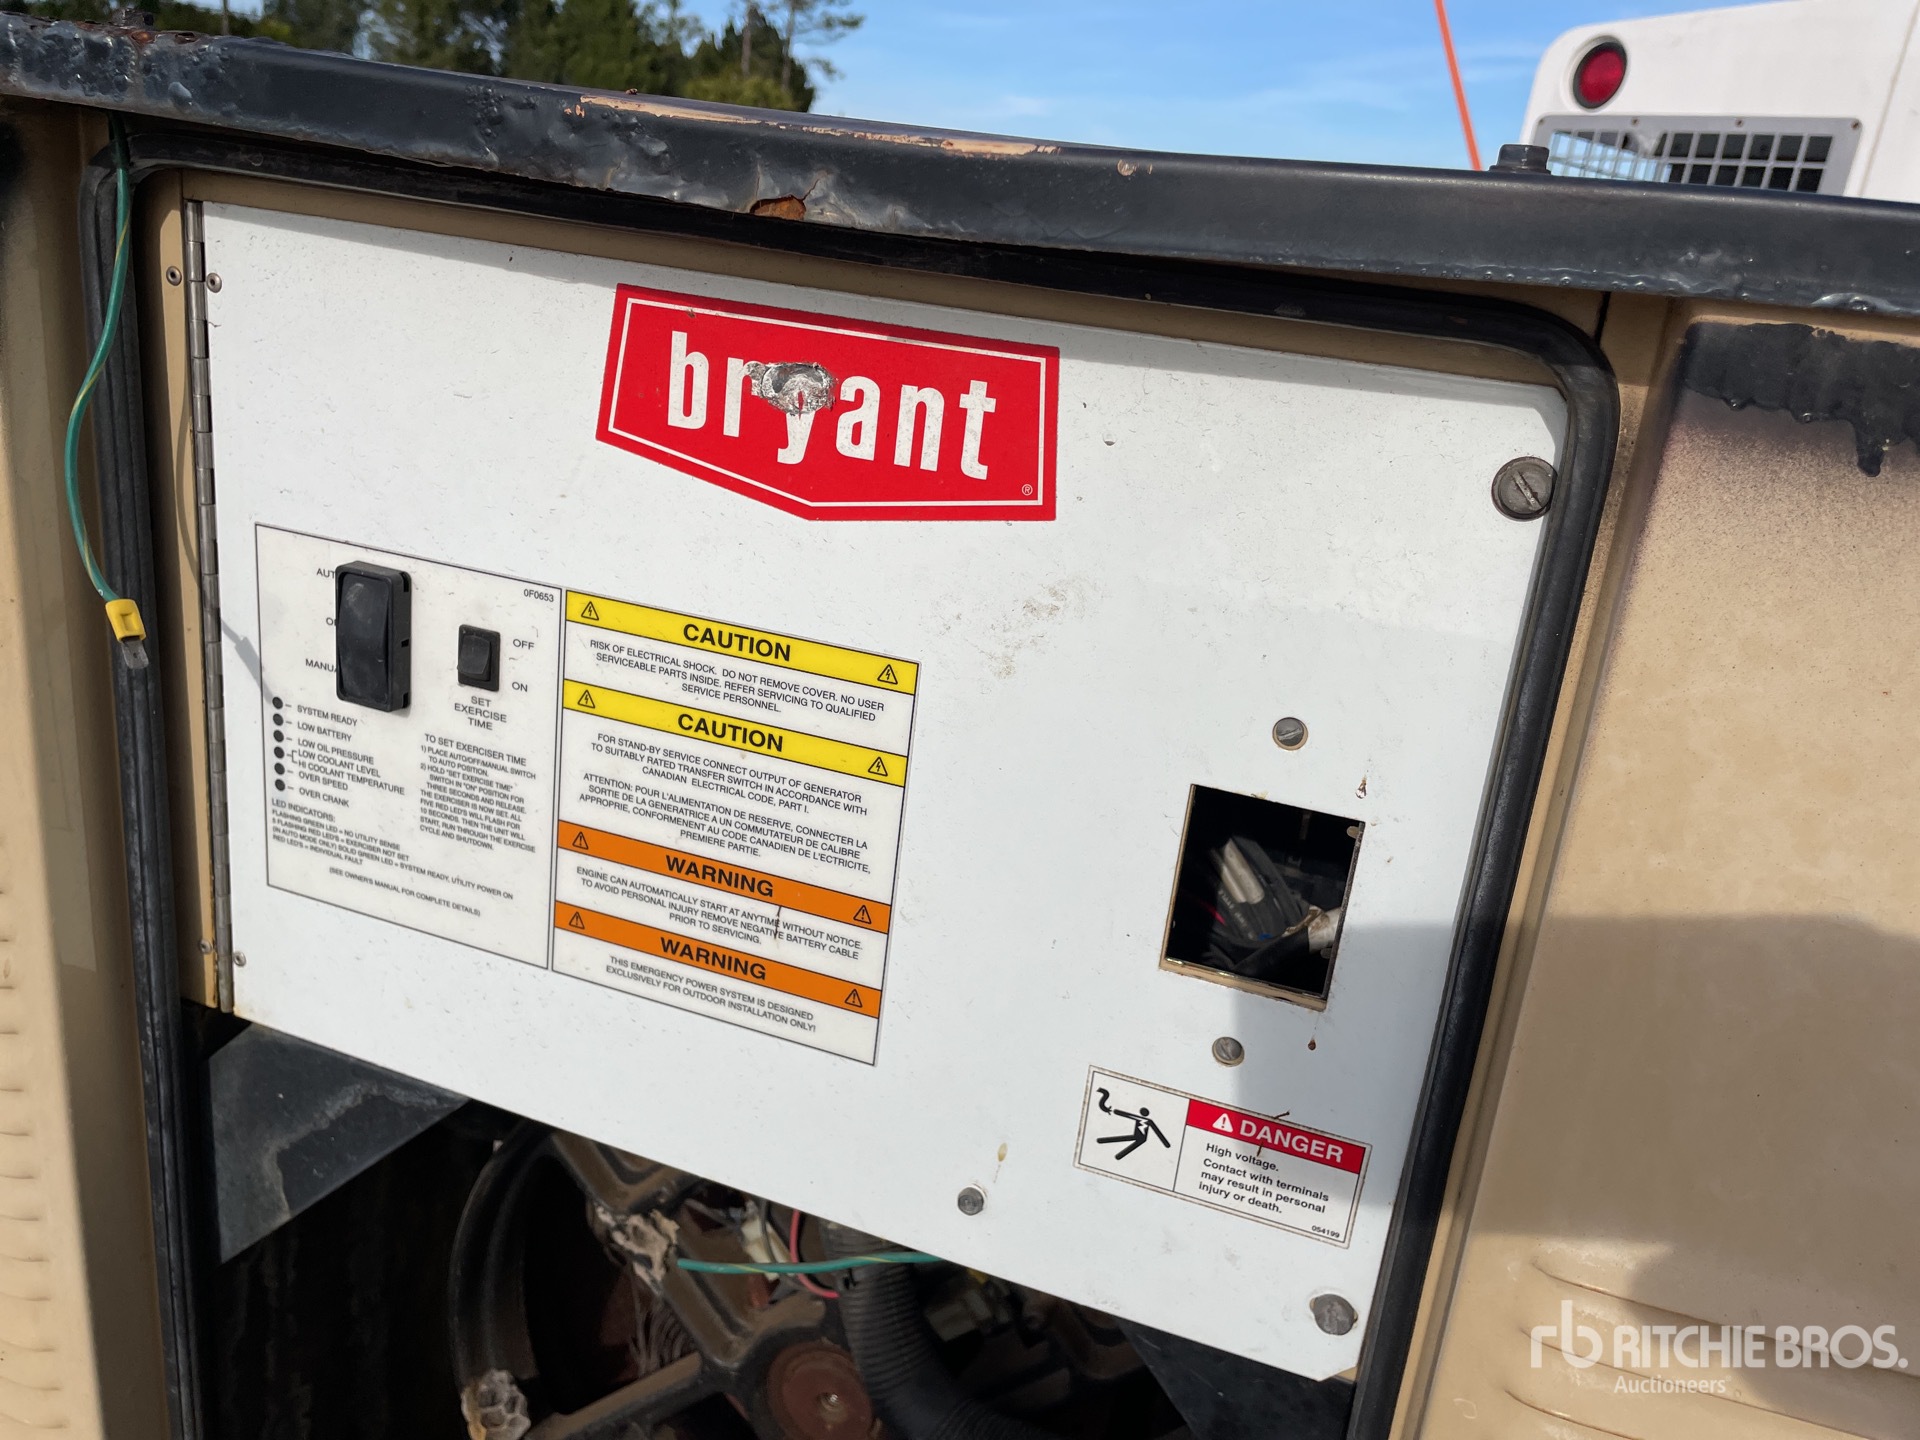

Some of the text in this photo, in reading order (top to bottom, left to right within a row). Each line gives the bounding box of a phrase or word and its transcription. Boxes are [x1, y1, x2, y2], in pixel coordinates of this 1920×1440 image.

[667, 330, 996, 480] bryant
[316, 567, 334, 579] AUT
[512, 638, 534, 650] OFF
[683, 623, 790, 662] CAUTION
[305, 658, 336, 673] MANU
[590, 639, 884, 711] RISK OF ELECTRICAL SHOCK. DO NOT REMOVE COVER. NO USER
[470, 695, 491, 707] SET
[511, 681, 528, 692] ON
[596, 652, 876, 721] SERVICEABLE PARTS INSIDE. REFER SERVICING TO QUALIFIED
[681, 682, 781, 712] SERVICE PERSONNEL.
[297, 704, 357, 726] SYSTEM READY
[454, 702, 506, 723] EXERCISE
[467, 716, 492, 730] TIME
[297, 721, 352, 741] LOW BATTERY
[677, 713, 783, 752] CAUTION
[297, 738, 374, 765] LOW OIL PRESSURE
[298, 748, 380, 778] LOW COOLANT LEVEL
[424, 733, 526, 766] TO SET EXERCISER TIME
[298, 759, 404, 795] HI COOLANT TEMPERATURE
[298, 770, 348, 791] OVER SPEED
[591, 742, 867, 816] TO SUITABLY RATED TRANSFER SWITCH IN ACCORDANCE WITH
[597, 733, 861, 803] FOR STAND-BY SERVICE CONNECT OUTPUT OF GENERATOR
[298, 786, 349, 807] OVER CRANK
[642, 765, 687, 784] CANADIAN
[691, 777, 746, 798] ELECTRICAL
[747, 791, 776, 806] CODE,
[778, 798, 802, 811] PART
[271, 797, 335, 822] LED INDICATORS:
[583, 772, 867, 850] ATTENTION: POUR L'ALIMENTATION DE RESERVE, CONNECTER LA
[588, 784, 619, 799] SORTIE
[621, 792, 633, 802] DE
[635, 796, 646, 806] LA
[647, 799, 709, 822] GENERATRICE
[719, 816, 732, 827] UN
[733, 820, 803, 845] COMMUTATEUR
[805, 838, 818, 849] DE
[820, 842, 860, 859] CALIBRE
[579, 793, 870, 874] APPROPRIE, CONFORMENENT AU CODE CANADIEN DE L'ECTRICITE,
[680, 829, 760, 856] PREMIERE PARTIE.
[665, 854, 773, 897] WARNING
[576, 866, 862, 950] ENGINE CAN AUTOMATICALLY START AT ANYTIME WITHOUT NOTICE.
[581, 877, 859, 960] TO AVOID PERSONAL INJURY REMOVE NEGATIVE BATTERY CABLE
[669, 912, 761, 944] PRIOR TO SERVICING.
[660, 936, 766, 980] WARNING
[605, 964, 816, 1032] EXCLUSIVELY FOR OUTDOOR INSTALLATION ONLY!
[610, 955, 813, 1020] THIS EMERGENCY POWER SYSTEM IS DESIGNED
[1205, 1142, 1279, 1173] High voltage.
[1239, 1119, 1344, 1163] DANGER
[1200, 1171, 1325, 1215] may result in personal
[1202, 1157, 1329, 1202] Contact with terminals
[1198, 1181, 1282, 1213] injury or death.
[1311, 1224, 1340, 1238] 054199
